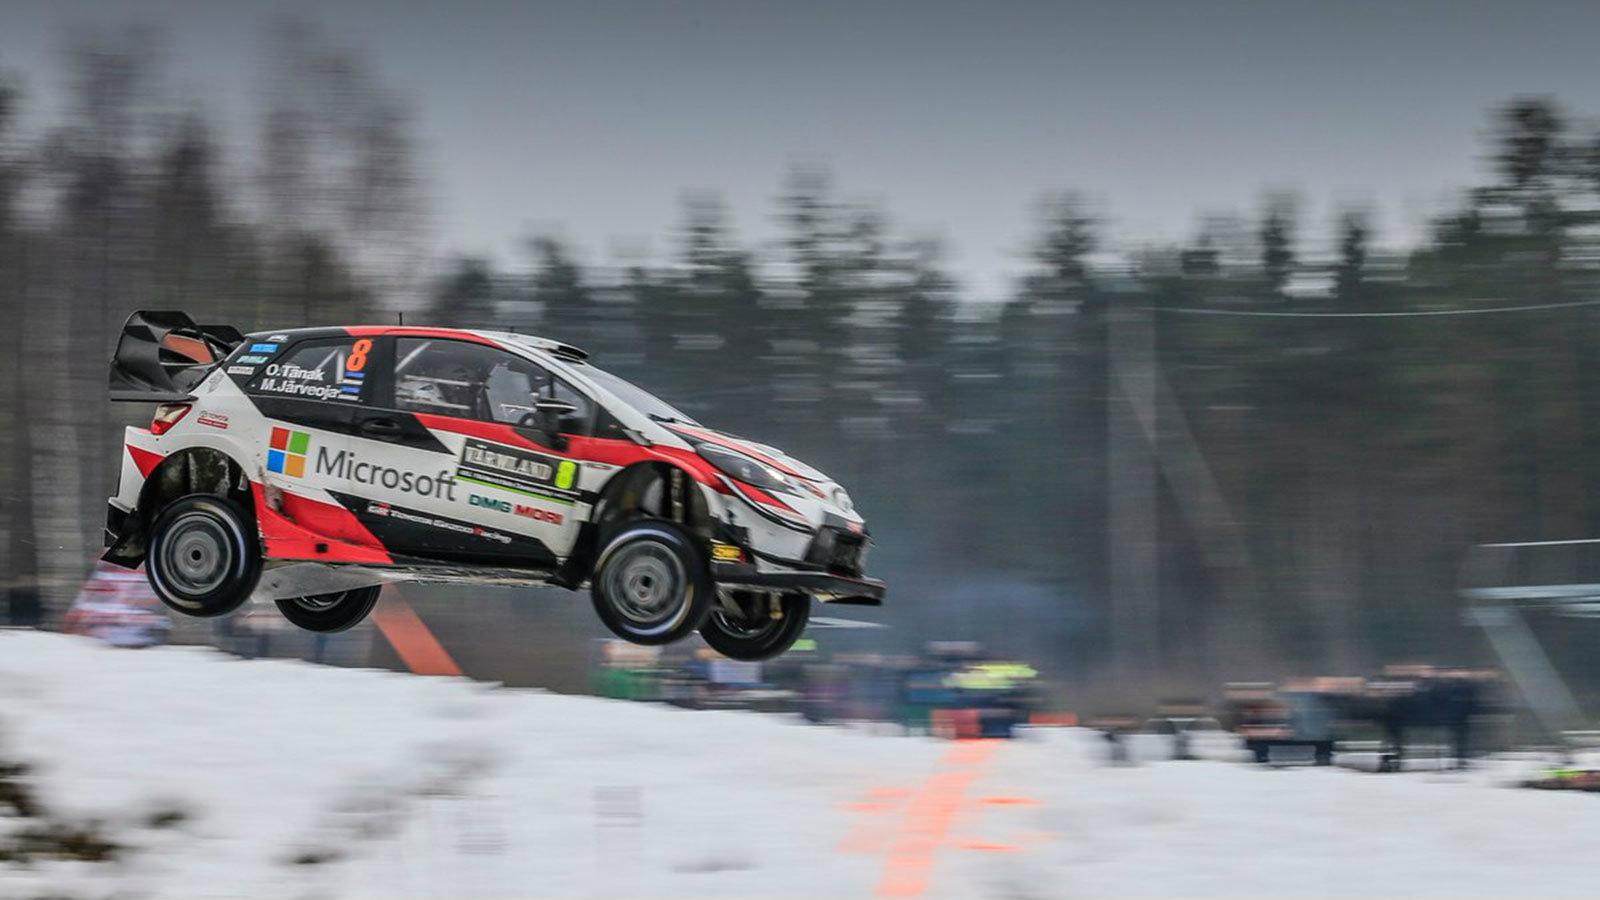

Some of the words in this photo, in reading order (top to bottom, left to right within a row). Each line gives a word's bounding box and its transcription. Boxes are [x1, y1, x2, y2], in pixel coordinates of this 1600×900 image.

[346, 339, 373, 371] 8
[316, 446, 457, 502] Microsoft
[469, 494, 512, 513] DMG
[514, 504, 564, 525] MORI
